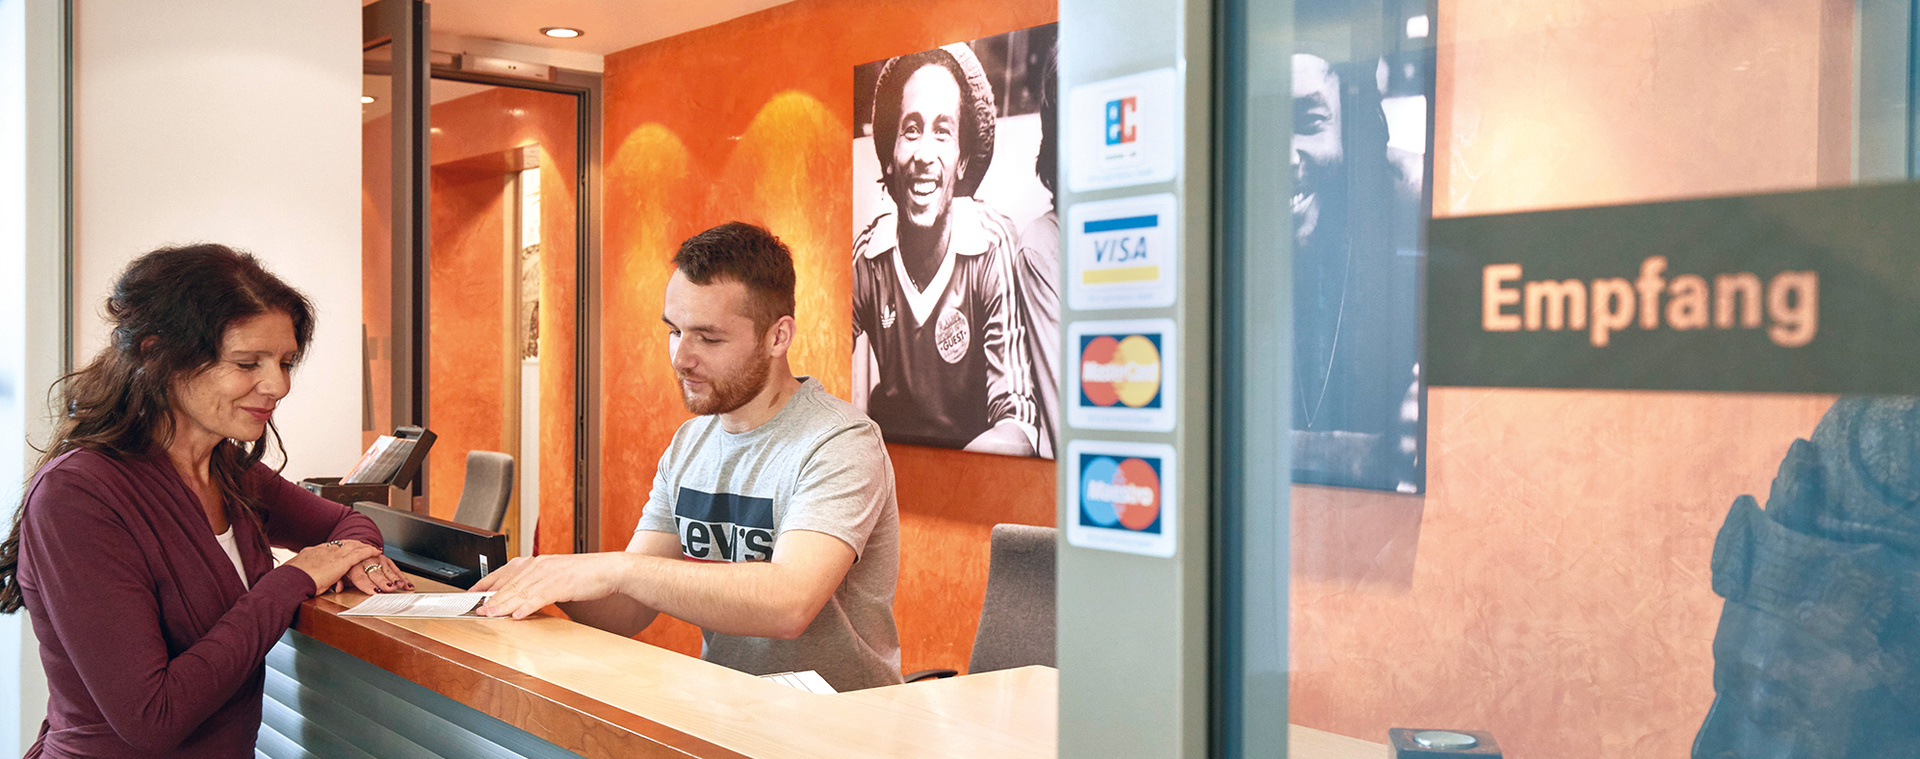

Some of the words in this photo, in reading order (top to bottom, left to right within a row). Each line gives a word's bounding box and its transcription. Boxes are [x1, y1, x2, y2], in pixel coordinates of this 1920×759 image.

[1093, 236, 1147, 262] VISA
[1481, 254, 1820, 348] Empfang
[943, 330, 965, 351] GUEST
[1081, 359, 1160, 383] MasterCard
[1086, 479, 1155, 507] Maestro
